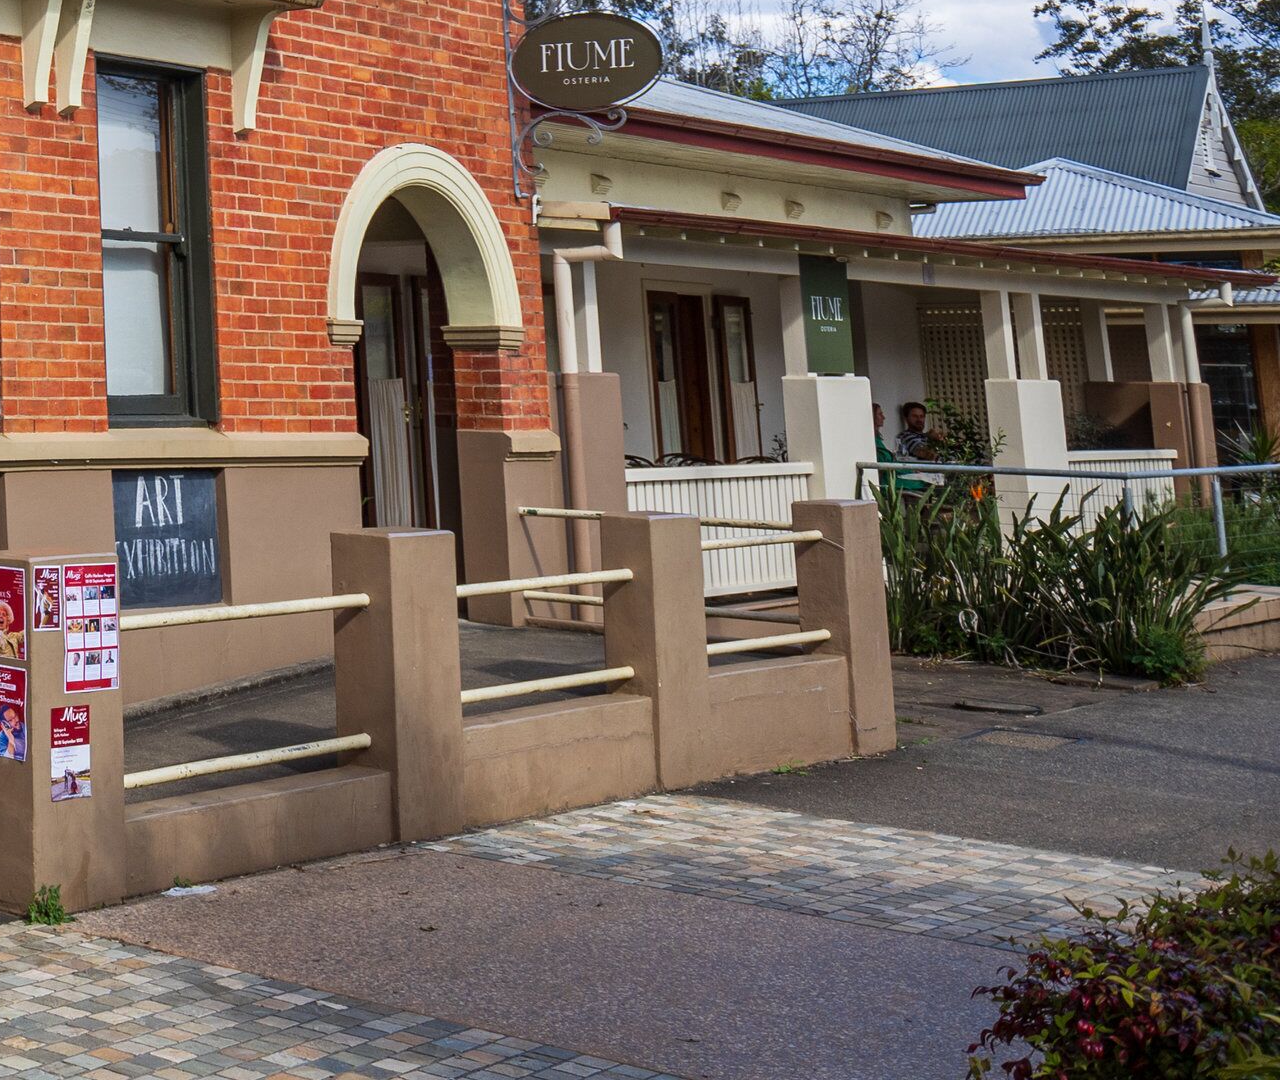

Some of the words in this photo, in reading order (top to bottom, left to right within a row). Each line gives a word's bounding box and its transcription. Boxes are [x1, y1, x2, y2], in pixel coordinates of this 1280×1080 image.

[540, 38, 635, 73] FIUME
[563, 76, 610, 85] OSTERIA
[811, 295, 844, 322] FIUME
[135, 475, 184, 527] ART
[60, 707, 88, 724] Muse
